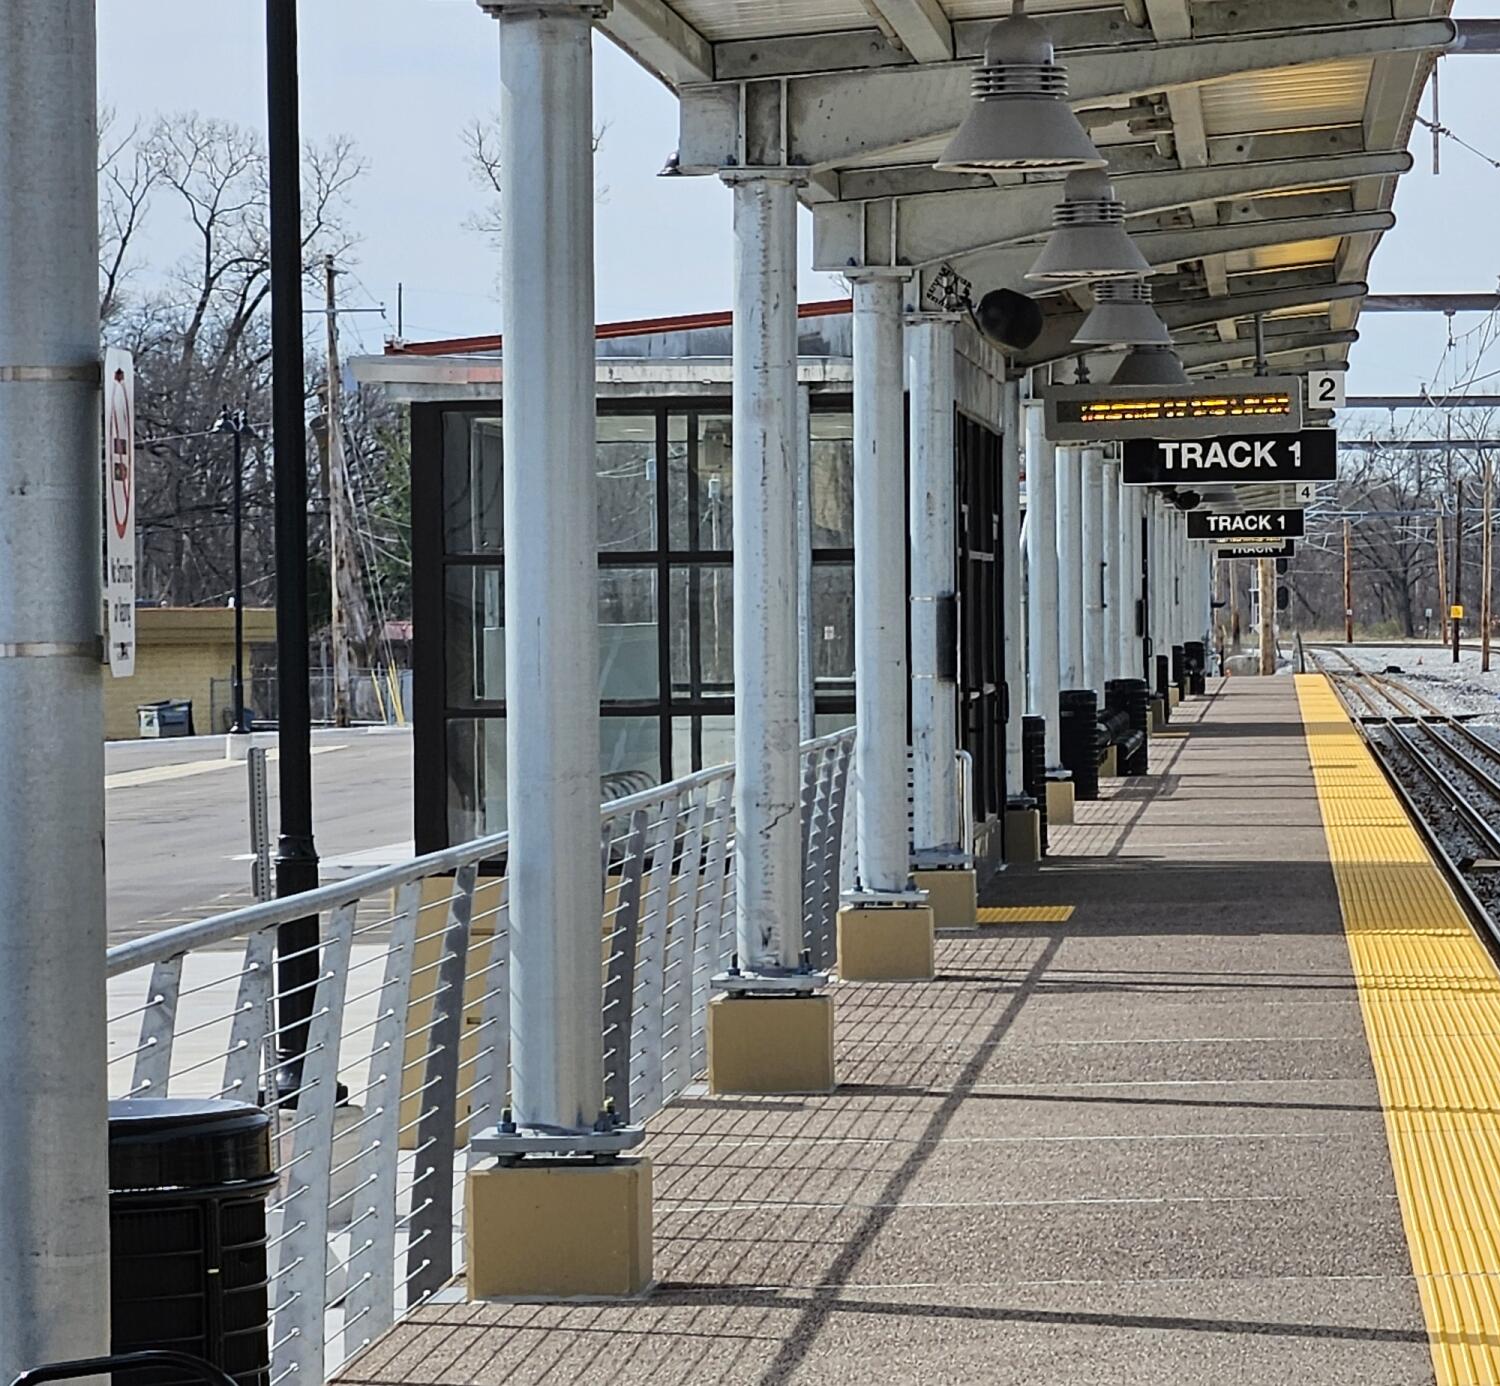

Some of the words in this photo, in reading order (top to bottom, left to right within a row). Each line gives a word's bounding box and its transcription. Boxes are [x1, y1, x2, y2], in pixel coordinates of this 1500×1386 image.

[1319, 377, 1336, 401] 2
[1158, 441, 1278, 469] TRACK
[1288, 441, 1301, 467] 1
[1301, 486, 1311, 499] 4
[1206, 515, 1272, 531] TRACK
[1277, 515, 1286, 530] 1
